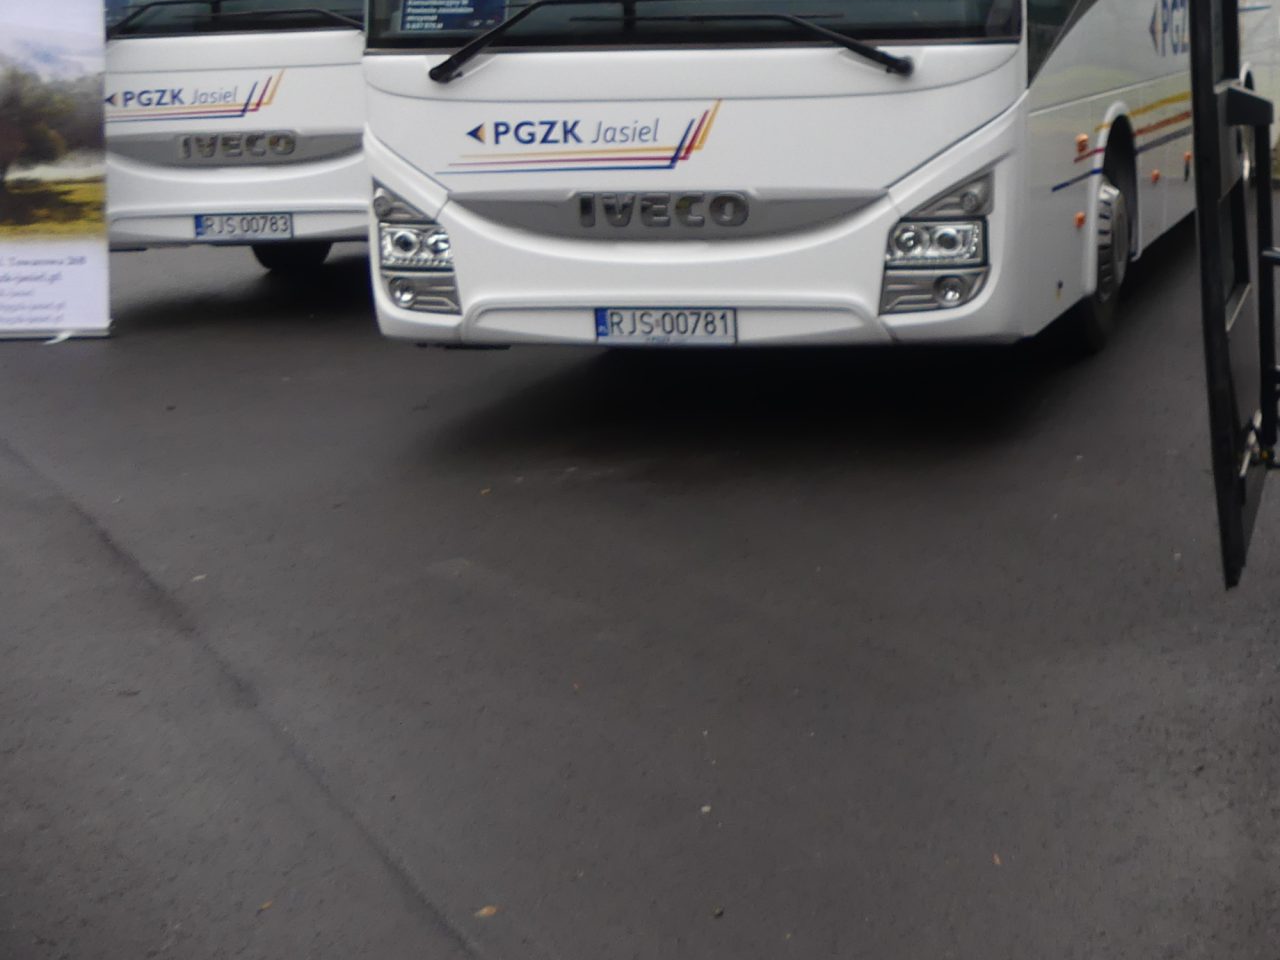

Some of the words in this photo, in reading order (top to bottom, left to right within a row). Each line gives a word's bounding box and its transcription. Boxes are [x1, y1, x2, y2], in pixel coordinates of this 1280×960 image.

[123, 88, 184, 107] PGZK
[190, 86, 239, 105] Jasiel
[493, 120, 583, 144] PGZK
[591, 118, 660, 143] Jasiel
[181, 133, 296, 159] IVECO
[577, 192, 750, 228] IVECO
[240, 215, 289, 233] 00783
[610, 311, 654, 335] RJS
[661, 311, 729, 335] 00781
